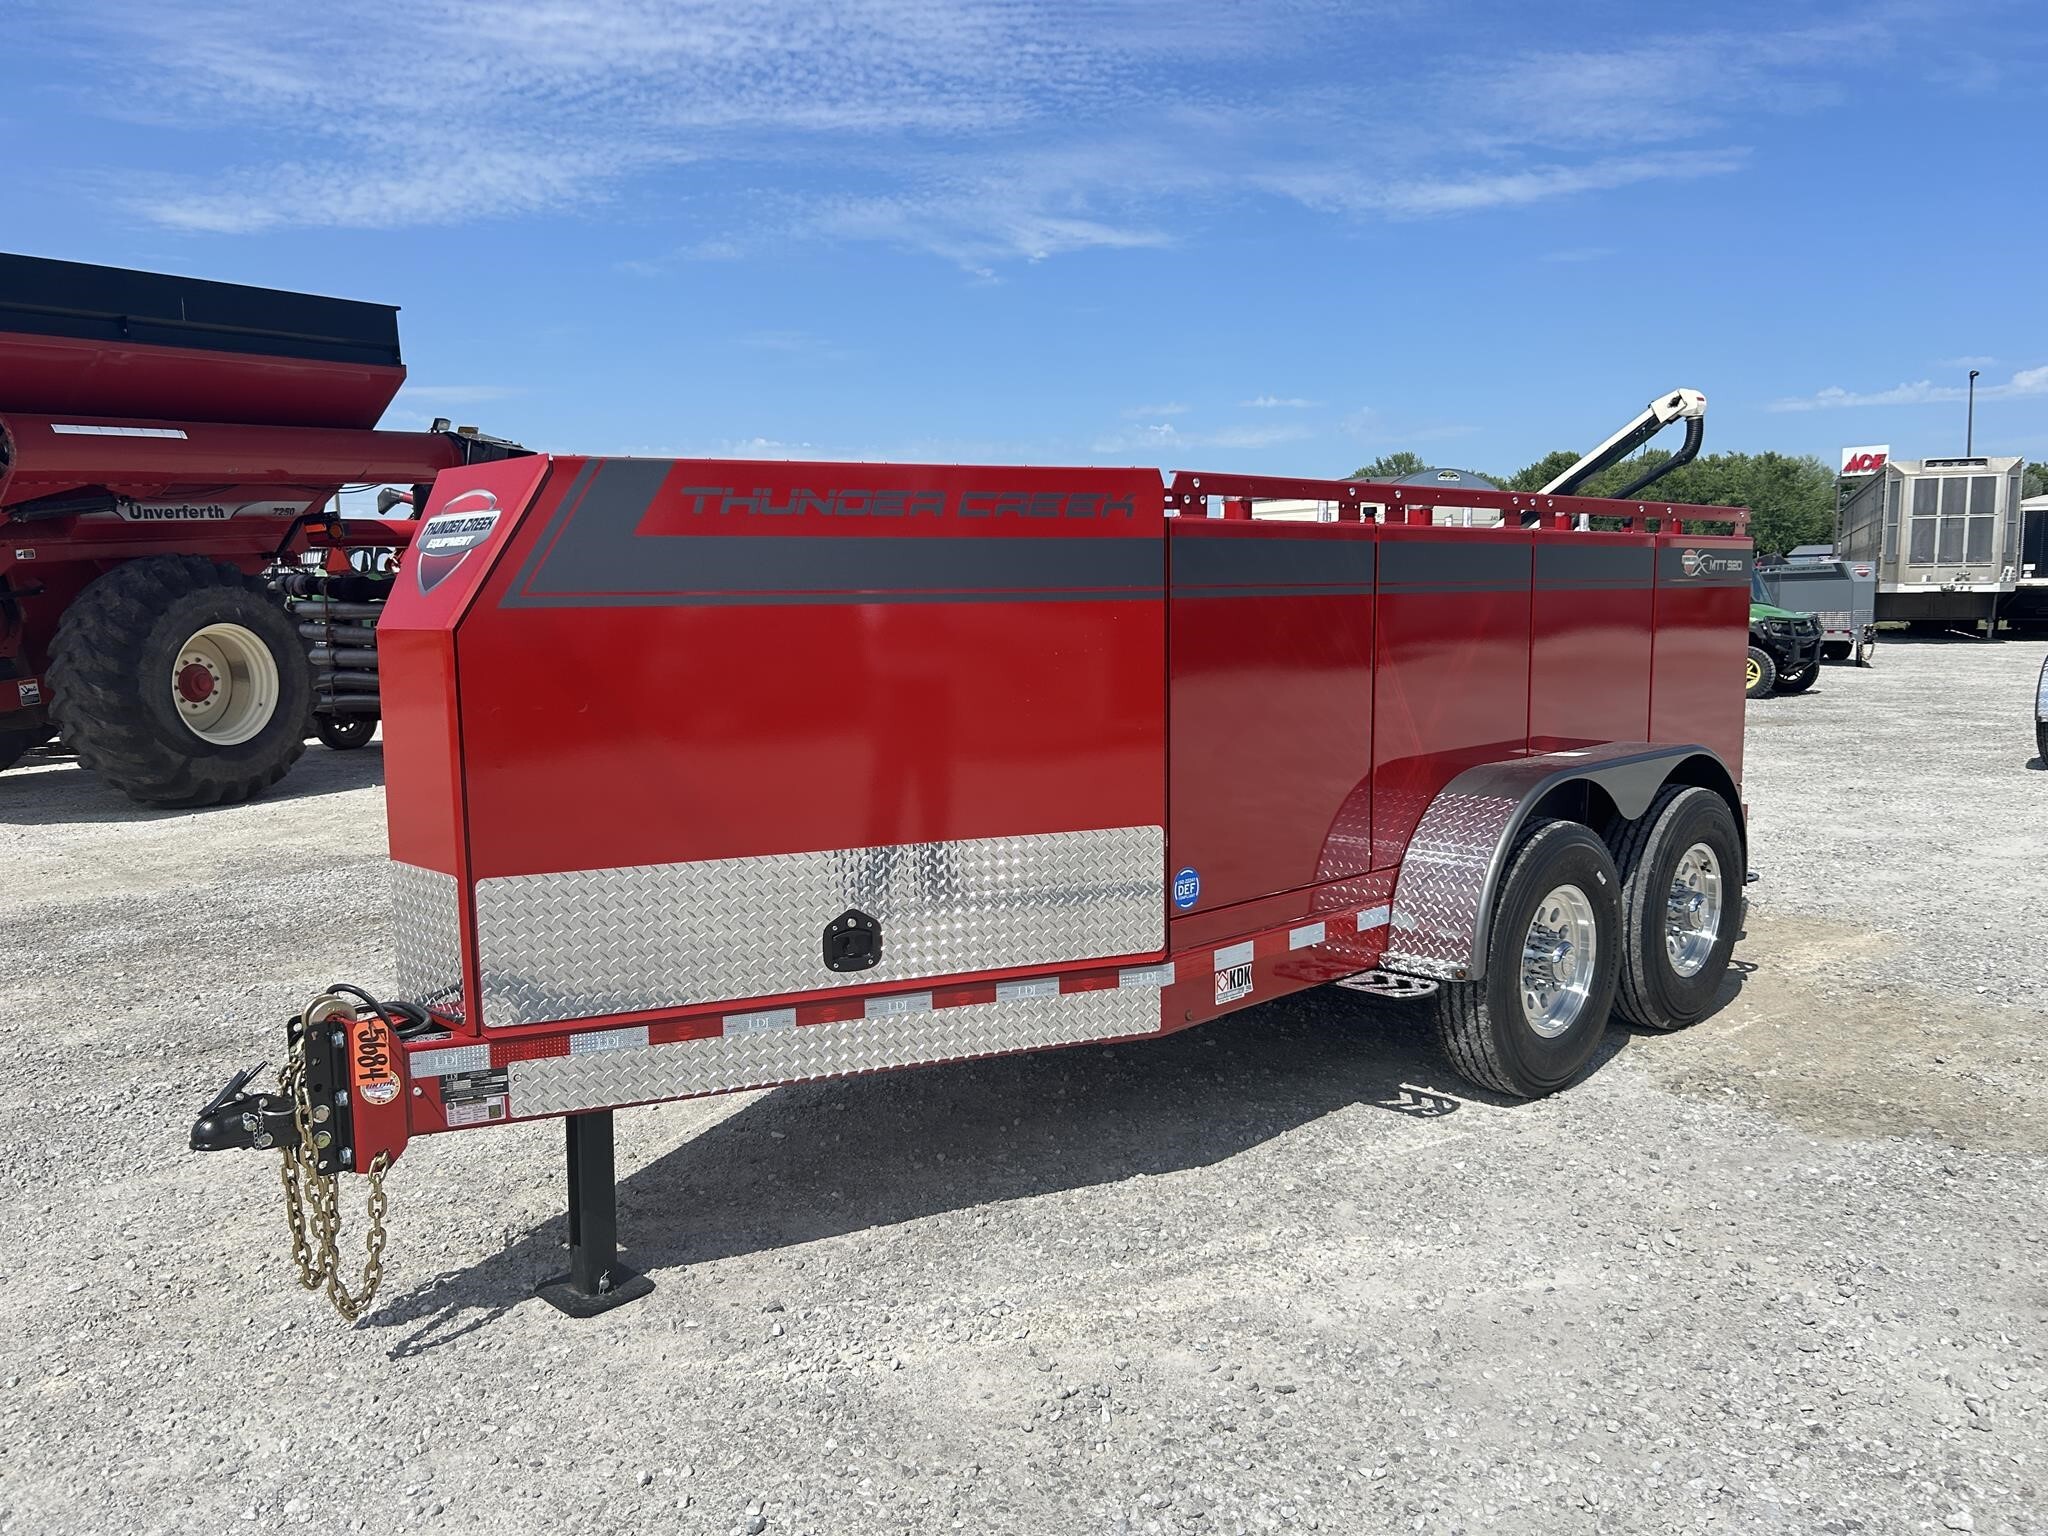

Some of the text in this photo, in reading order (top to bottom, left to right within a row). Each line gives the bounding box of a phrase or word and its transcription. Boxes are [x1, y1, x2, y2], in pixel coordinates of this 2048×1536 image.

[1843, 452, 1887, 472] ACE
[129, 502, 296, 520] Unverferth 7250
[680, 486, 1136, 519] THUNDER CREEK
[423, 515, 497, 536] THUNDER CREEK
[426, 535, 476, 550] EQUIPMENT
[1709, 559, 1727, 571] MTT
[1177, 882, 1196, 896] DEF
[1229, 965, 1251, 990] KDK
[888, 1000, 908, 1012] LDJ
[358, 1027, 388, 1081] 5684
